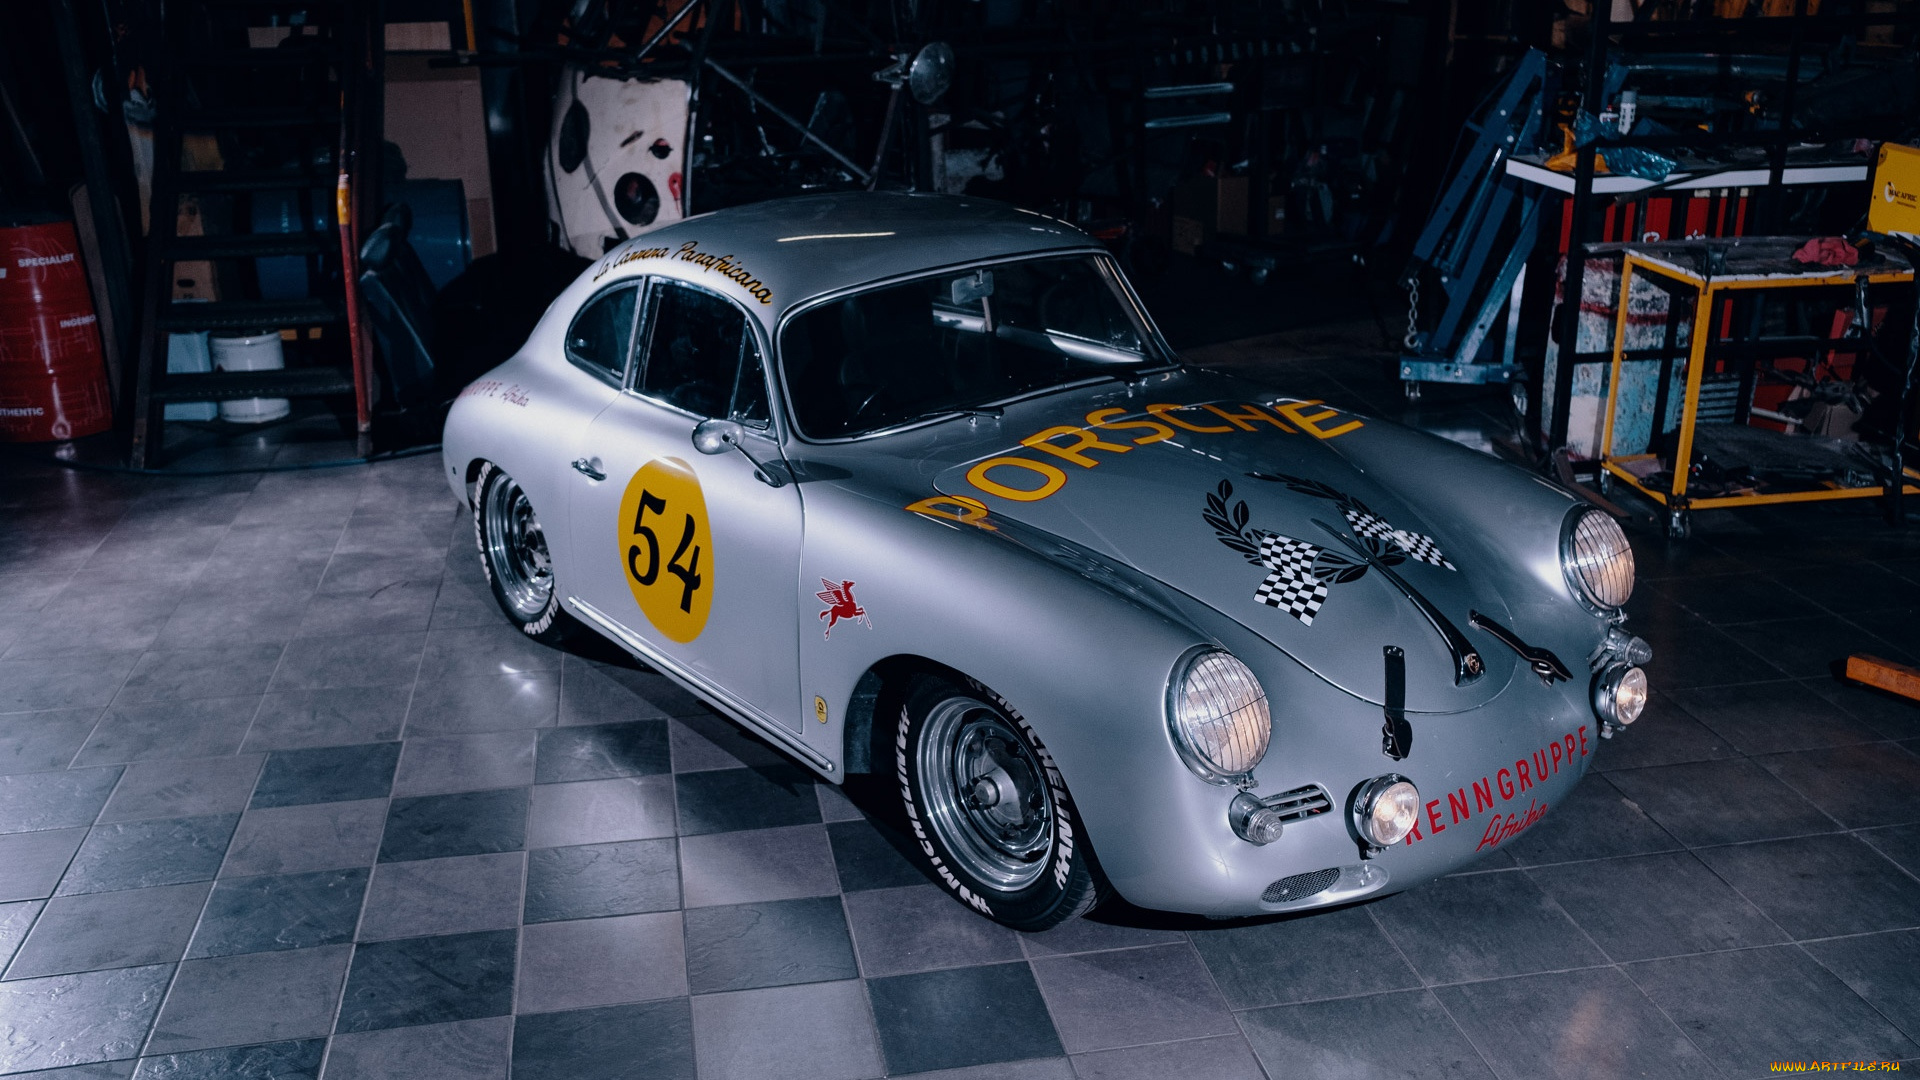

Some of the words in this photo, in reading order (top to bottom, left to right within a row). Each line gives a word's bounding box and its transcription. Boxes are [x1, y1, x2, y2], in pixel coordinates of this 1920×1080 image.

[18, 253, 75, 267] SPECIALIST
[593, 257, 611, 282] La
[612, 244, 670, 270] Carrera
[671, 240, 774, 306] Panafricana
[903, 399, 1365, 531] PORSCHE
[628, 488, 702, 615] 54
[896, 747, 960, 889] MICHELIN
[1405, 725, 1589, 846] RENNGRUPPE
[1475, 798, 1549, 852] Afrika
